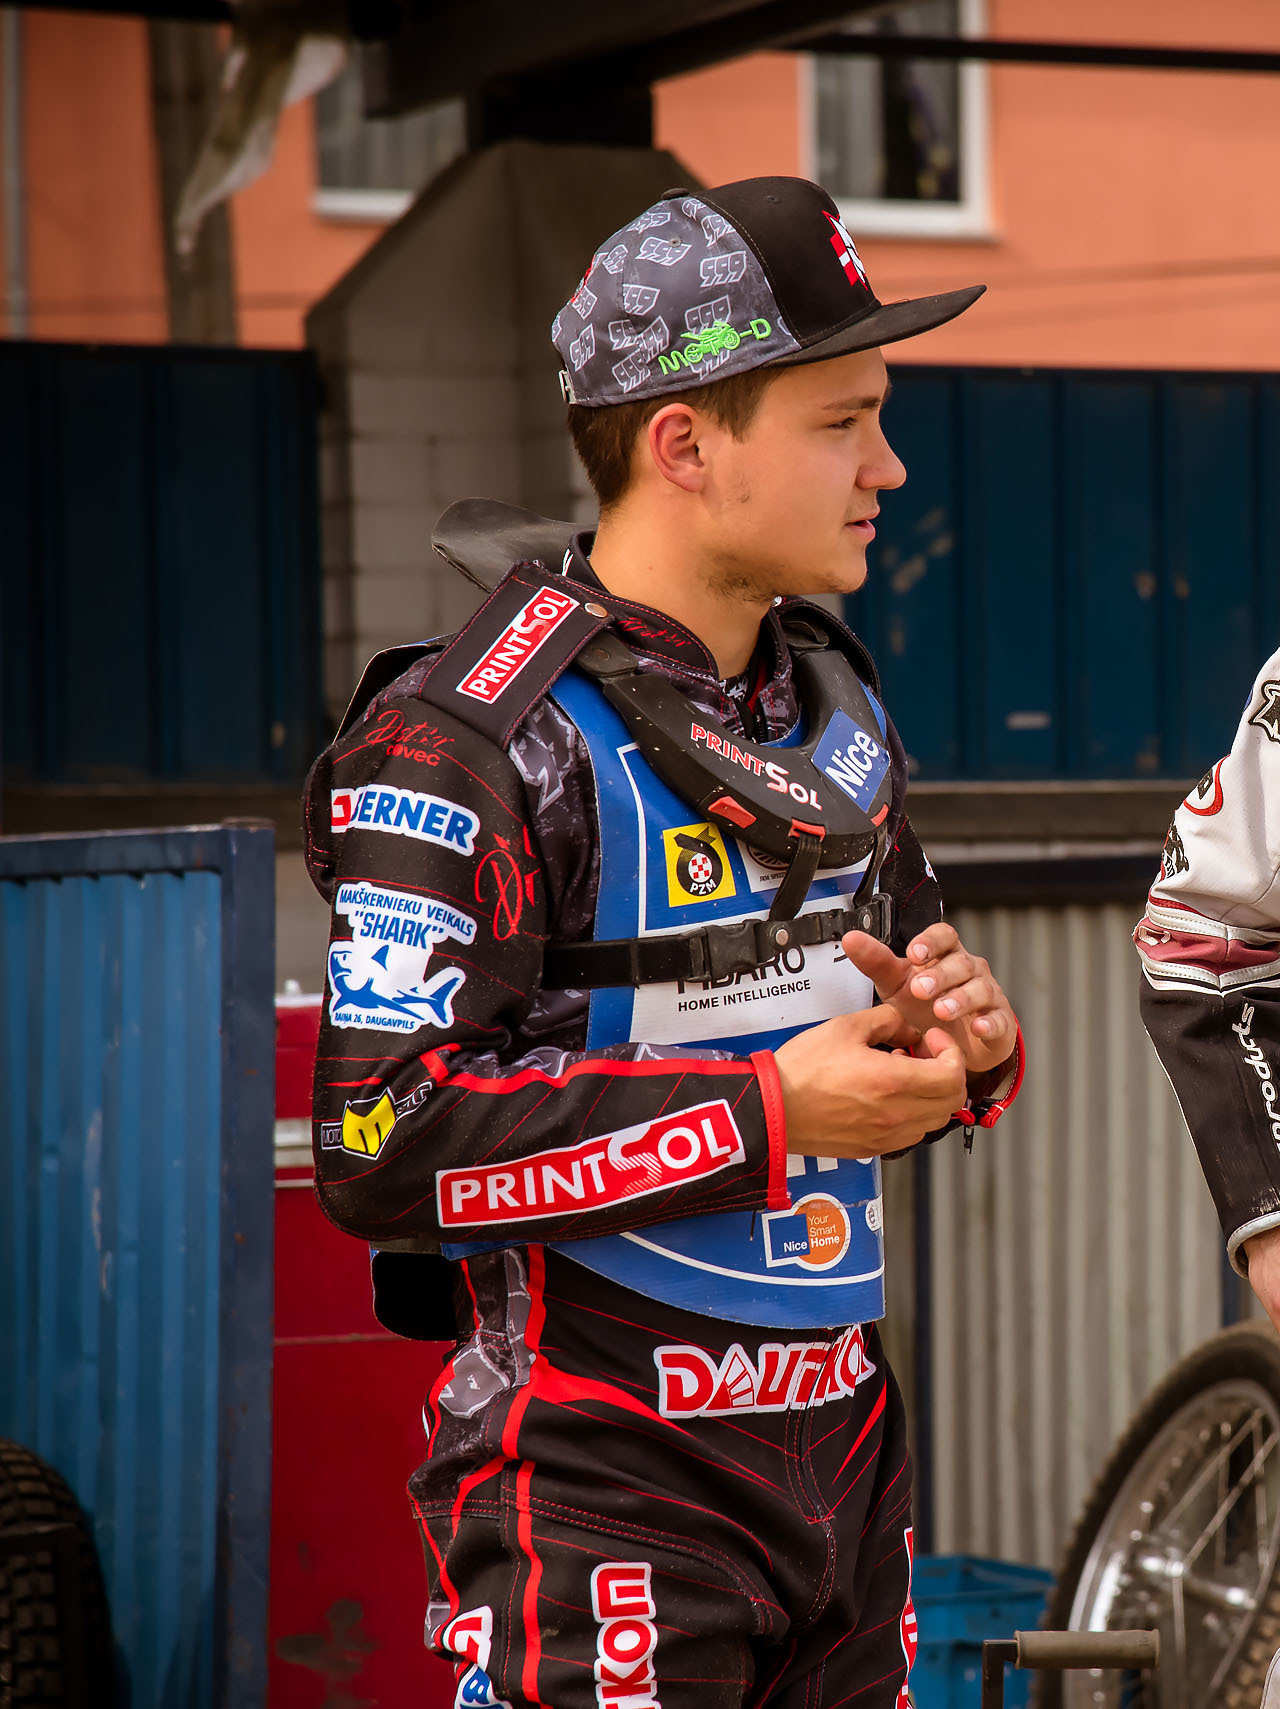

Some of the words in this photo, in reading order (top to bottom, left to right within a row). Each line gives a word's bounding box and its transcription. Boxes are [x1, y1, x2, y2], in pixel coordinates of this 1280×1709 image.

[824, 730, 879, 799] Nice
[689, 879, 717, 895] PZM
[427, 904, 474, 937] VEIKALS
[678, 996, 719, 1012] HOME
[723, 979, 811, 1006] INTELLIGENCE
[365, 1014, 416, 1030] DAUGAVPILS
[808, 1215, 829, 1226] Your
[809, 1224, 837, 1238] Smart
[783, 1241, 808, 1253] Nice
[810, 1235, 840, 1249] Home
